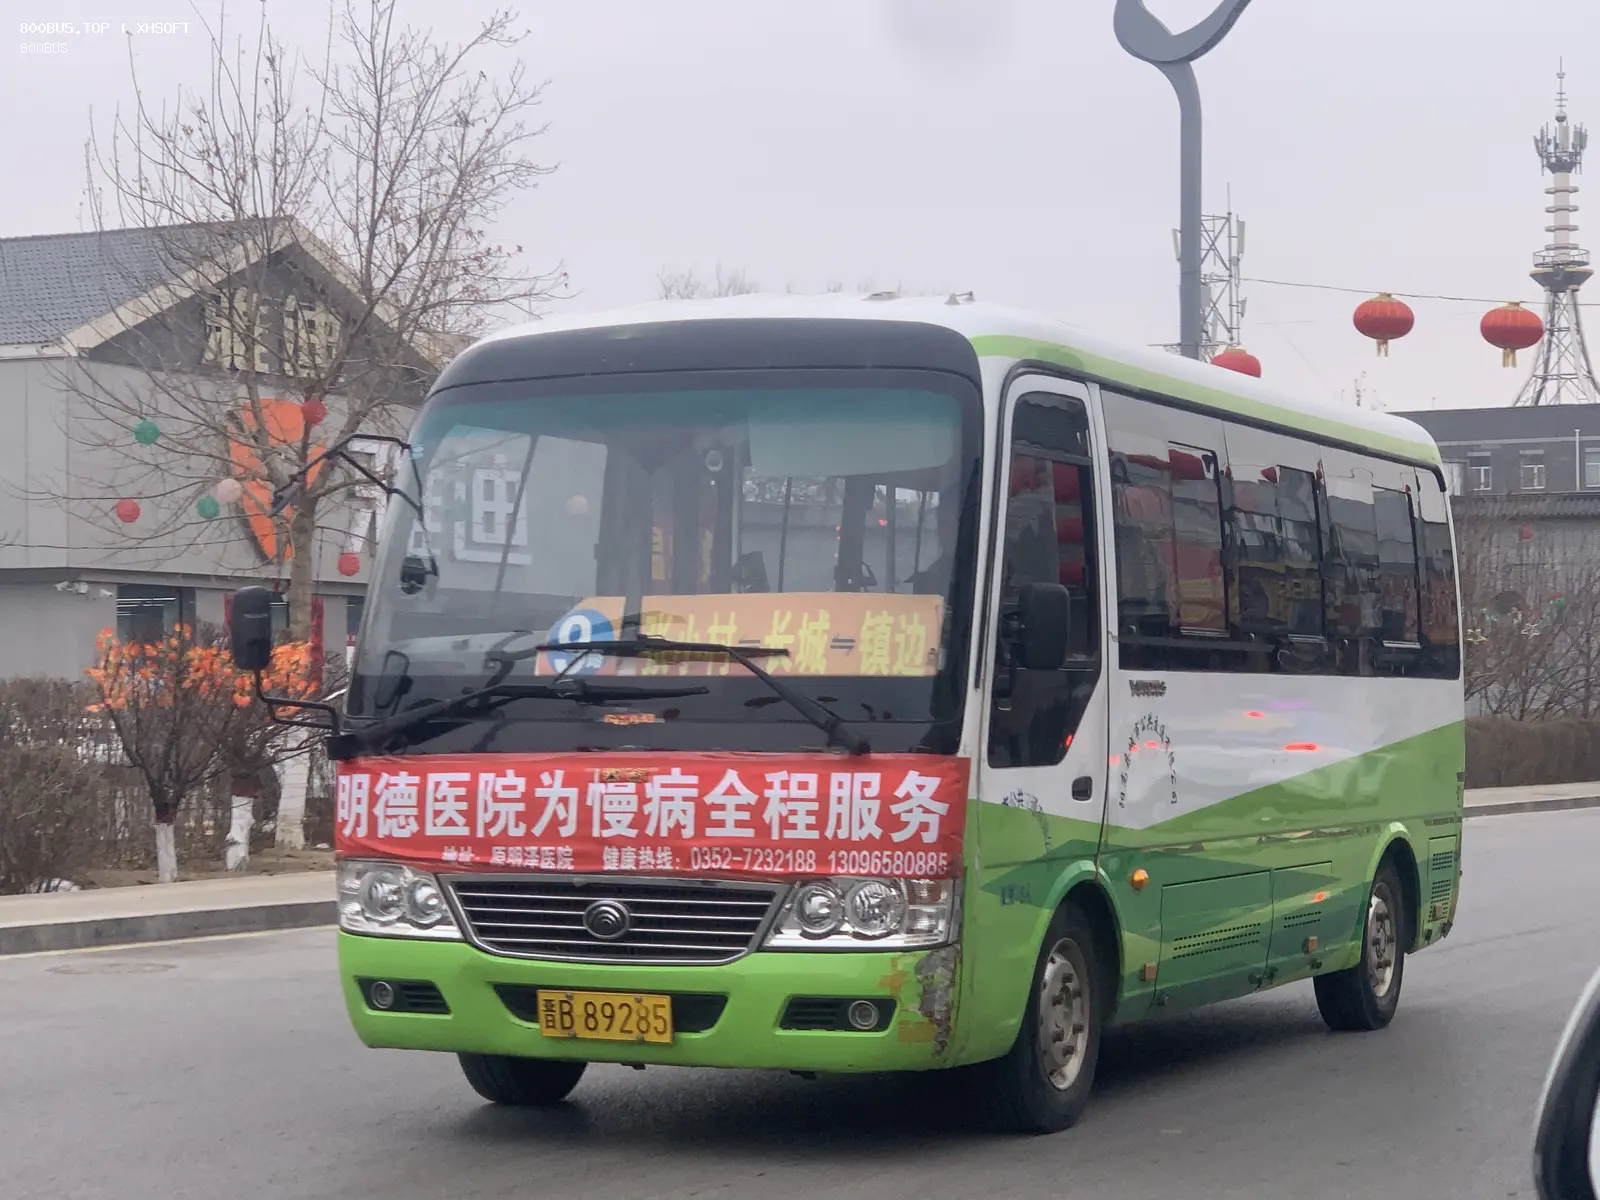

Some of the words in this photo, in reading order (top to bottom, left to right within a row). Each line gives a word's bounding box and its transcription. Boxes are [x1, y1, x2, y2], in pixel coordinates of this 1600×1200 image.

[337, 767, 950, 843] 明德医院为慢病全程服务
[690, 846, 817, 872] 0352-7232188
[828, 850, 948, 875] 13096580885
